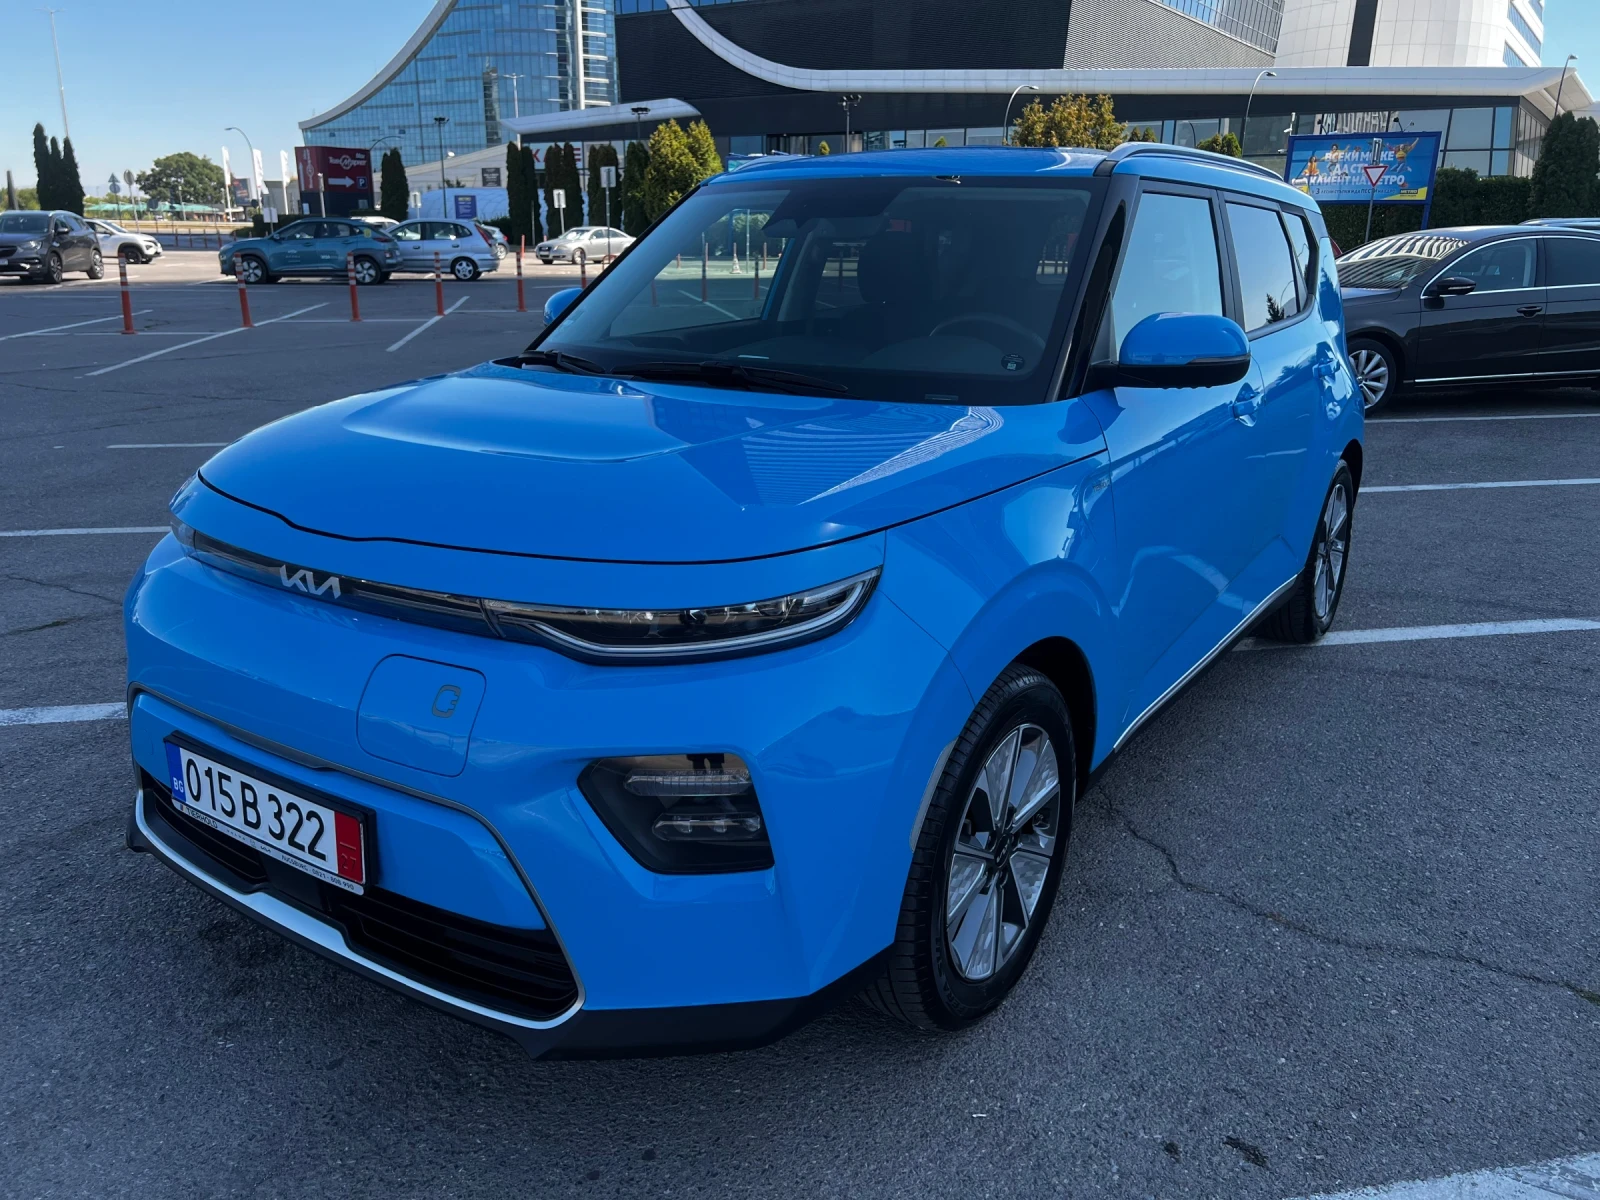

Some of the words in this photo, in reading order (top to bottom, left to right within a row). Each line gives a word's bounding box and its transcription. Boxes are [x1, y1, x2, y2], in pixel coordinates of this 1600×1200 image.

[1315, 187, 1320, 195] 3
[279, 564, 341, 599] KIA
[172, 777, 184, 794] BG
